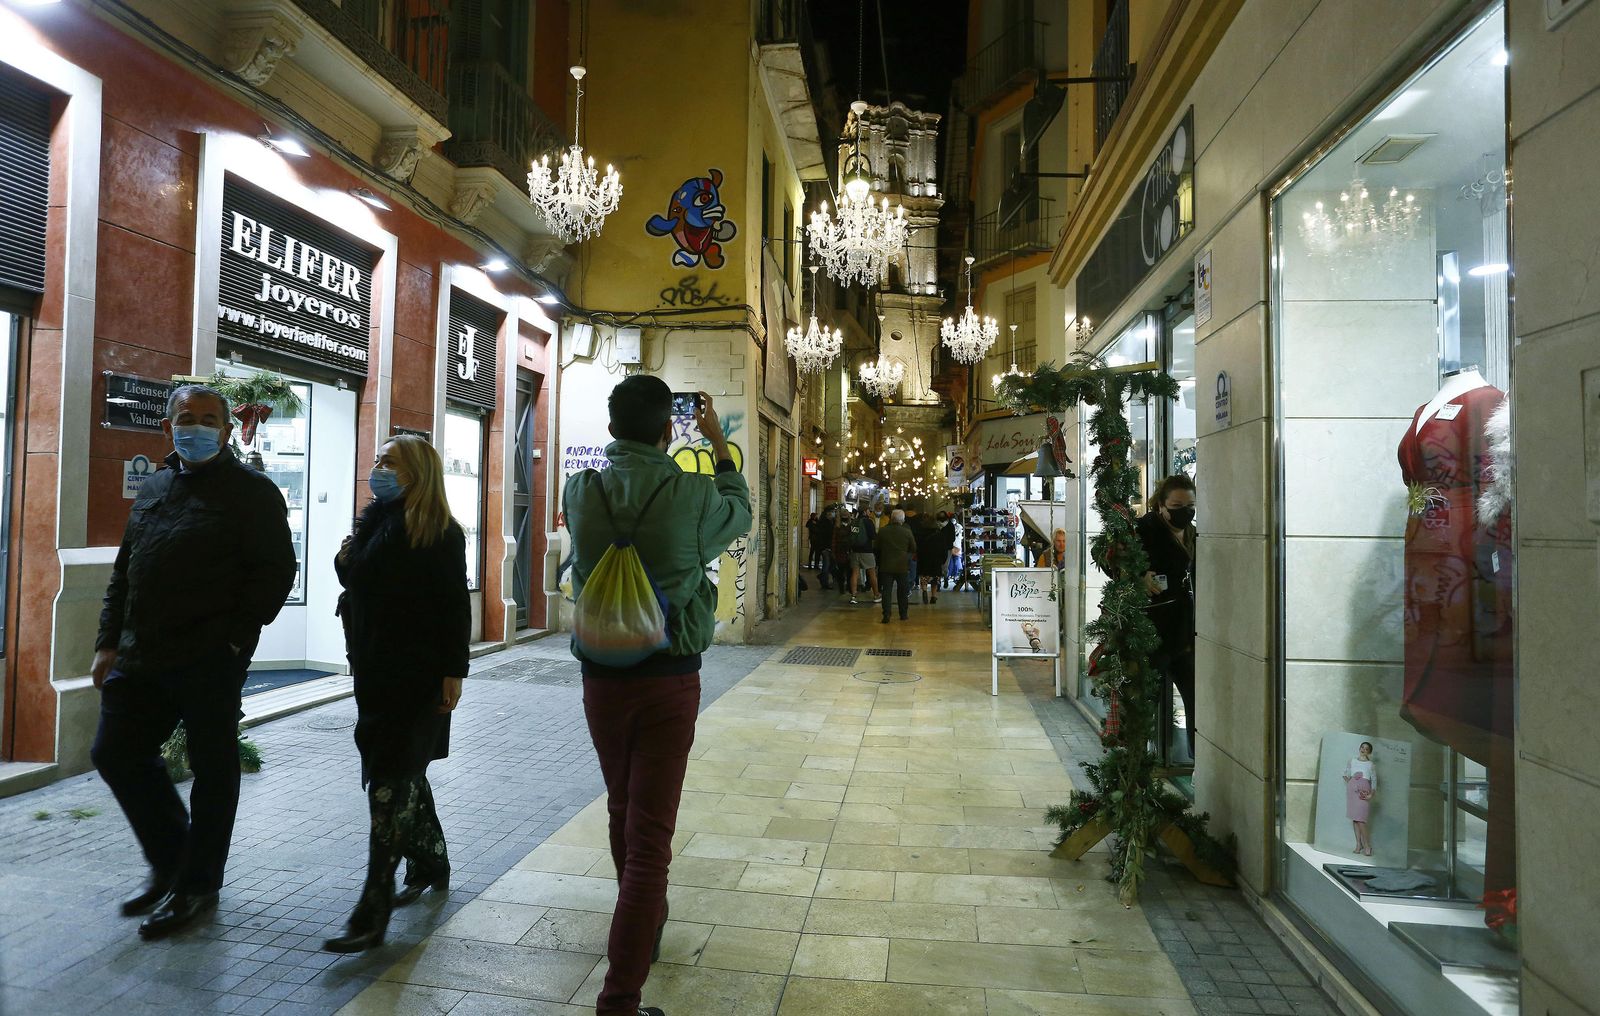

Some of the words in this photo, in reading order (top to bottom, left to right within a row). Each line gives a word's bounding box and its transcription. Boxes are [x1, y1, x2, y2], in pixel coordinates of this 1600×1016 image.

[229, 210, 362, 302] ELIFER
[254, 272, 361, 330] joyeros
[217, 304, 367, 362] www.joyeriaelifer.com
[124, 381, 169, 398] Licensed
[130, 412, 161, 427] Valuer
[986, 435, 1010, 450] Lola
[566, 446, 606, 457] ANDALU
[565, 458, 611, 469] LEVANTA
